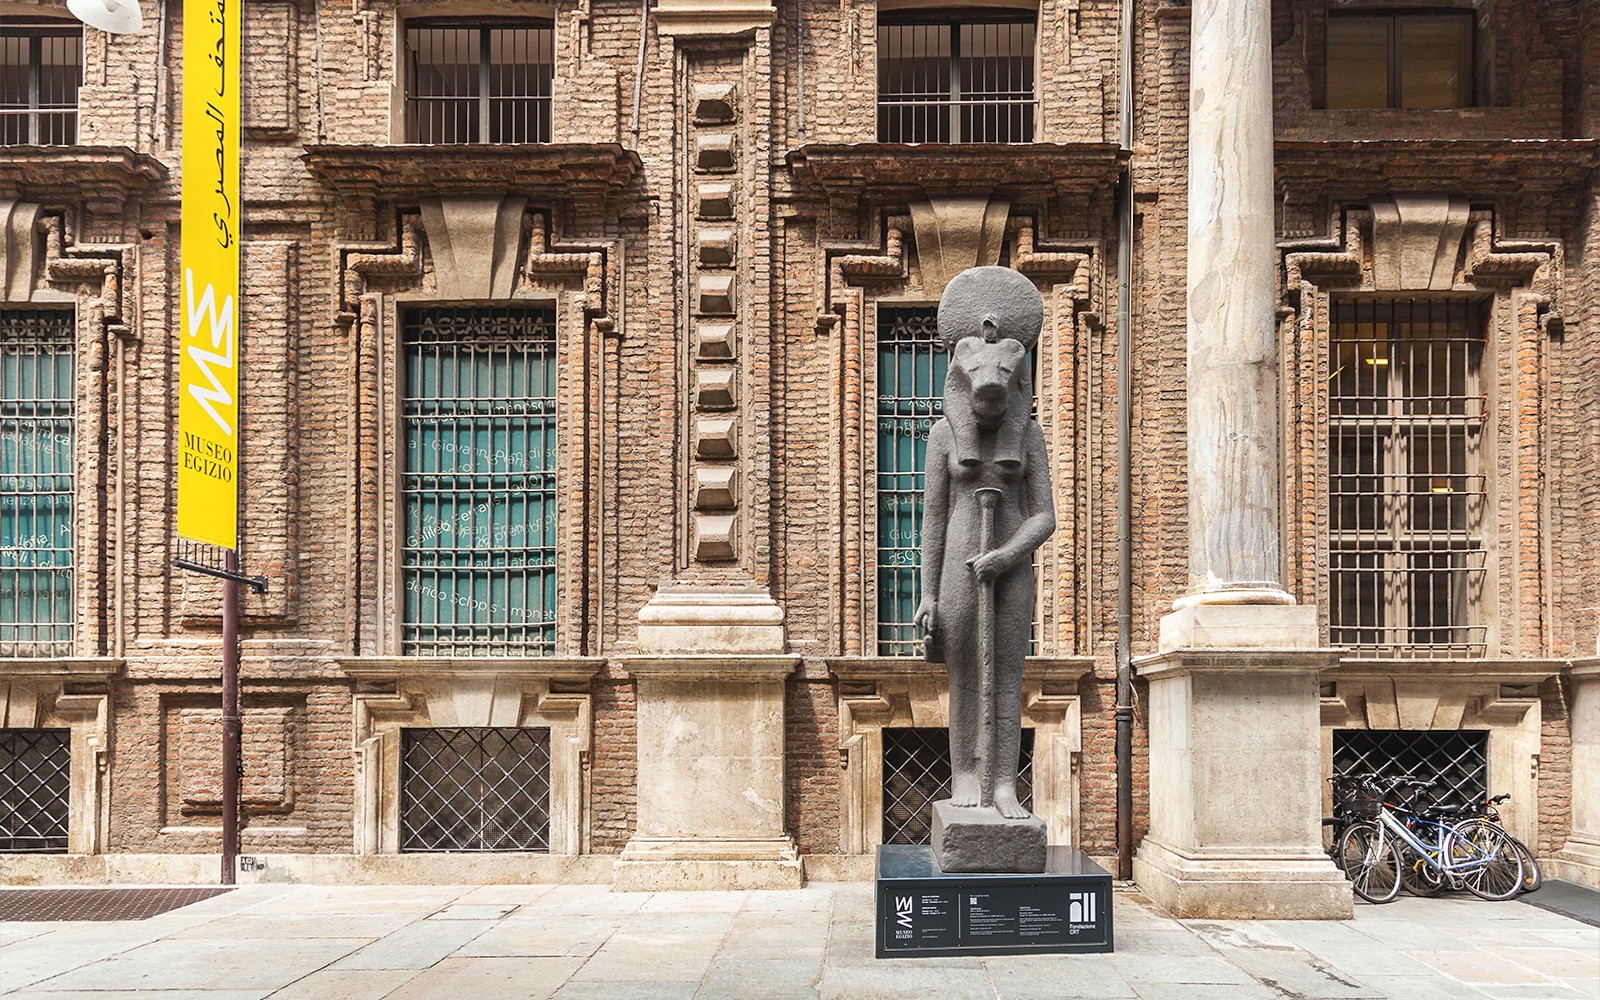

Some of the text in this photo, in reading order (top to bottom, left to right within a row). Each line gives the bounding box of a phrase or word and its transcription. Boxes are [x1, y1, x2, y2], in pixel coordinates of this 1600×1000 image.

[421, 316, 549, 335] ACCADEMIA
[461, 336, 549, 353] SCIENZE
[184, 431, 232, 464] MUSEO
[184, 451, 232, 483] EGIZIO
